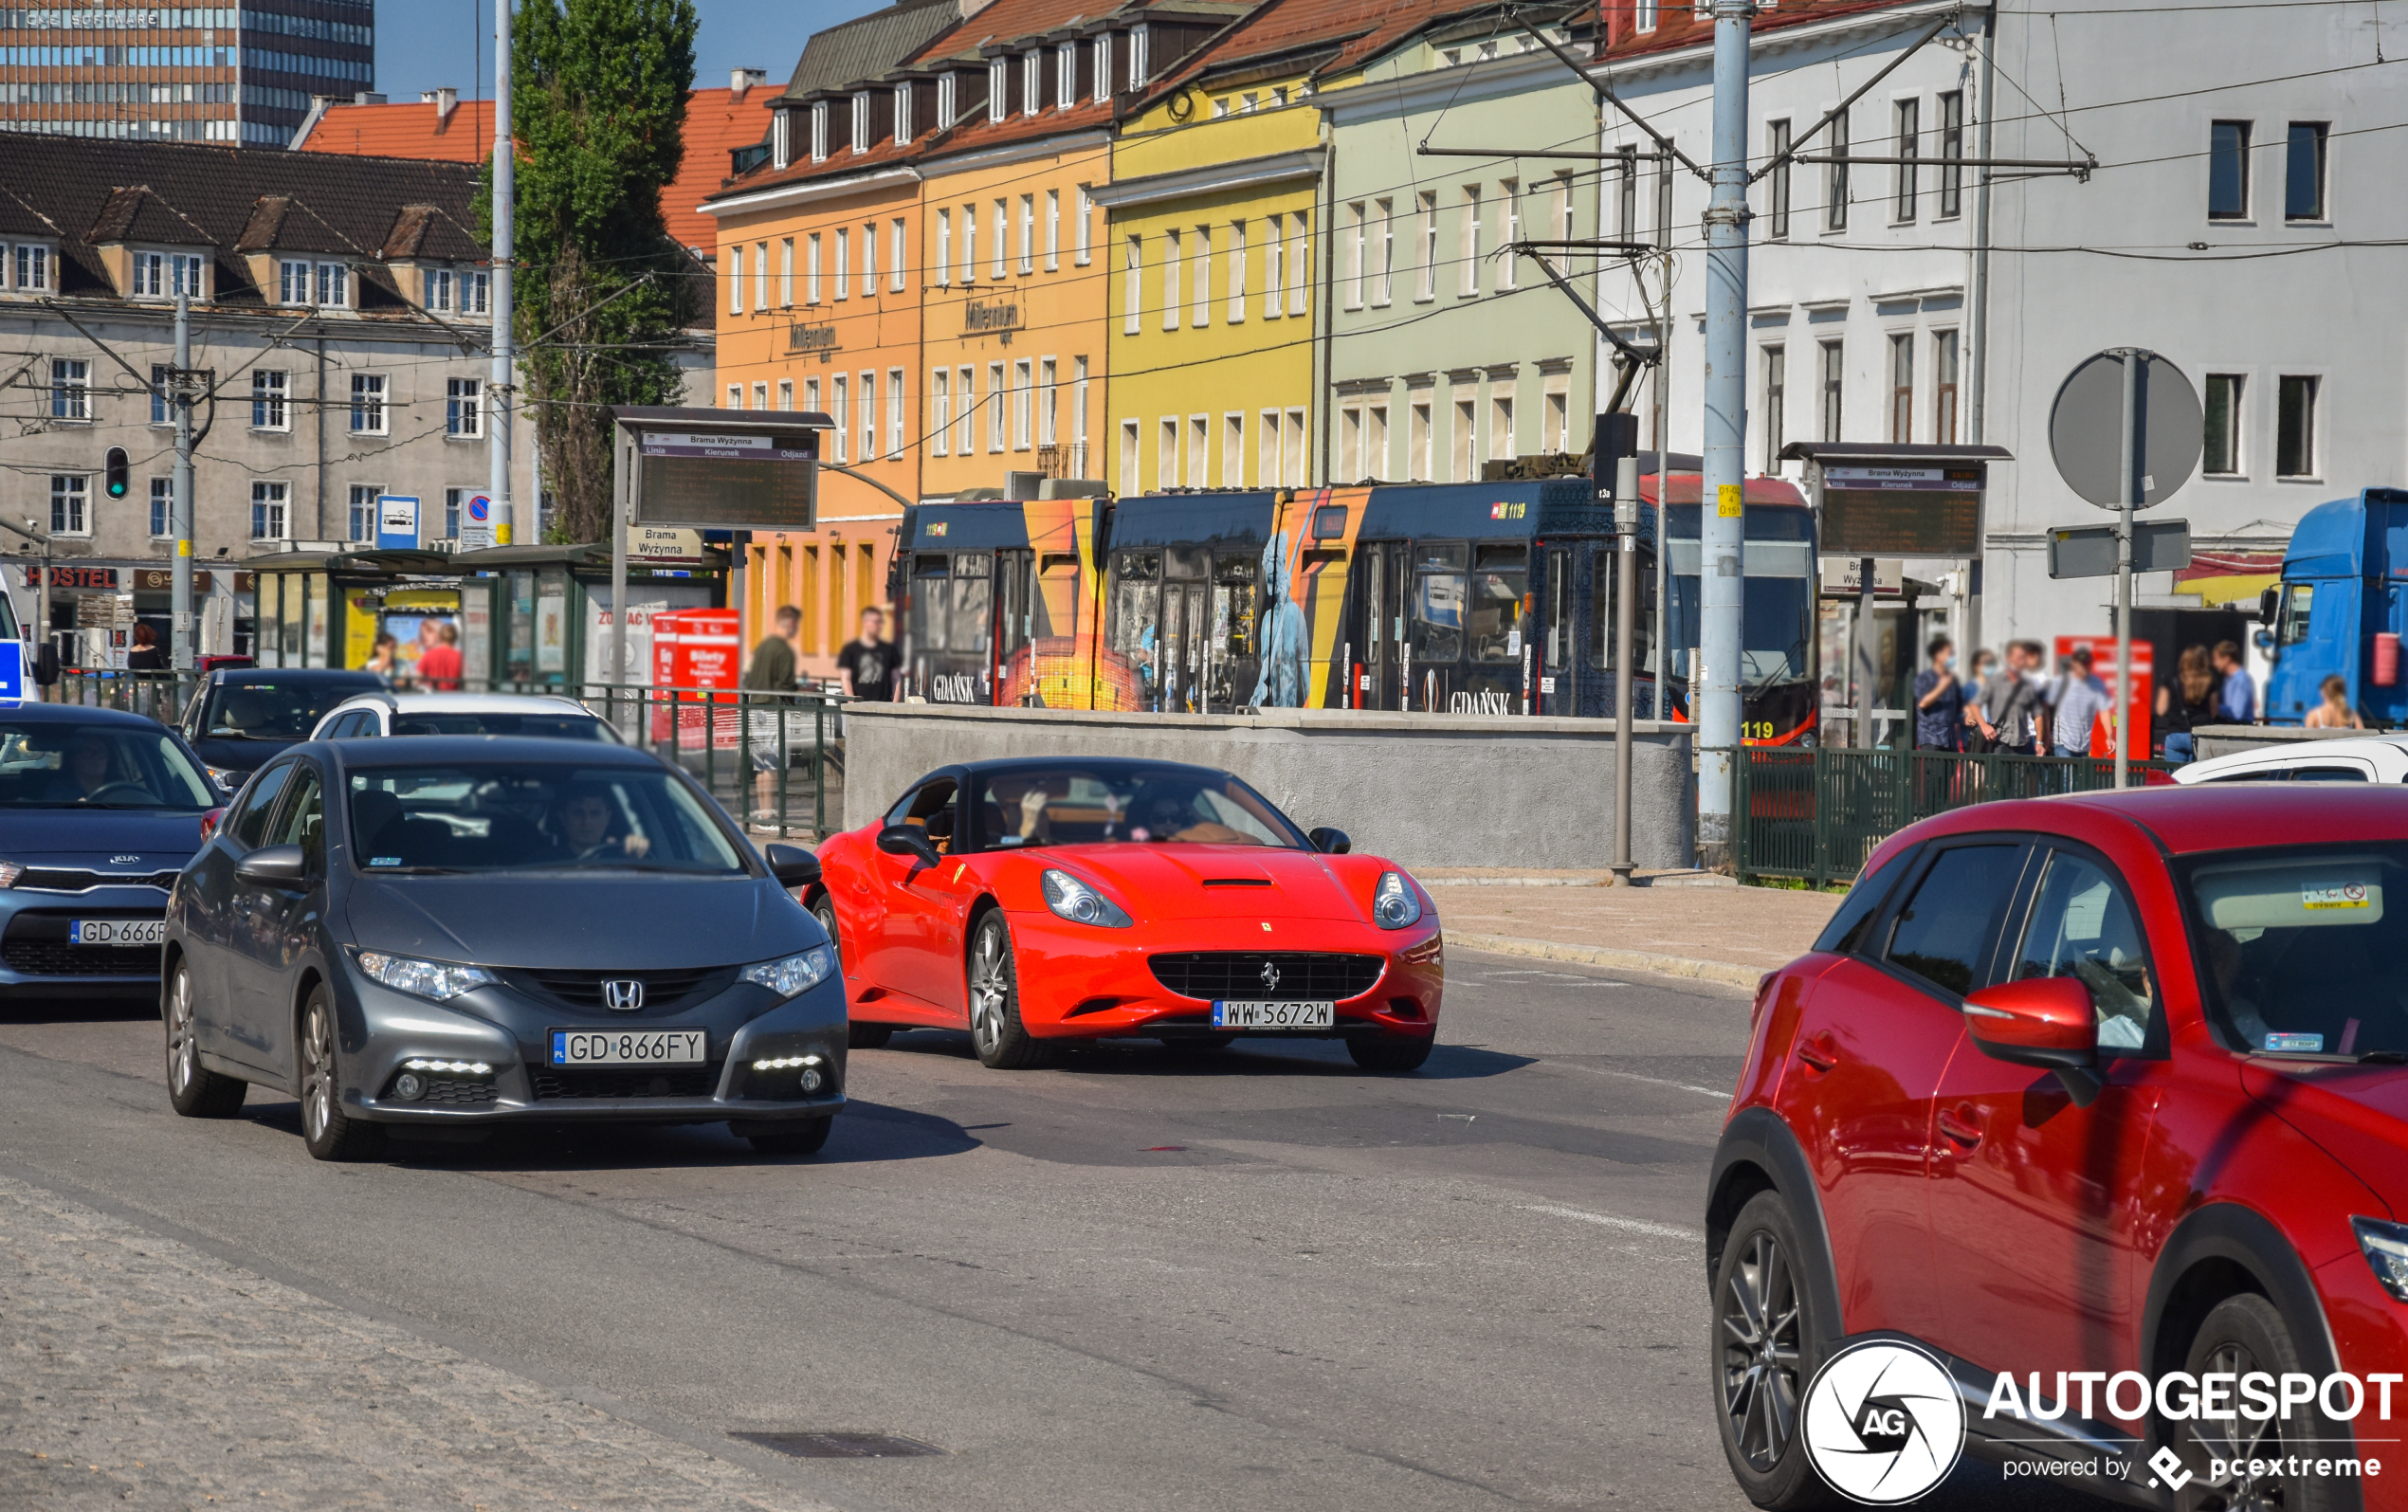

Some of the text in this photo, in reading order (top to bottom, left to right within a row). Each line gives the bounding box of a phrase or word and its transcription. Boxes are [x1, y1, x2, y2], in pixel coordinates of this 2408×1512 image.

[71, 14, 157, 26] SOFTWARE
[965, 298, 1018, 331] Millennium
[790, 318, 836, 350] Millennium
[690, 436, 753, 446] Brama Wyżynna
[704, 448, 739, 457] Kierunek
[780, 450, 808, 459] Odjazd
[1893, 470, 1925, 479] Wyżynna
[1508, 502, 1526, 519] 1119
[645, 529, 677, 539] Brama
[926, 523, 938, 537] 1119
[638, 543, 683, 556] Wyżynna
[1850, 561, 1877, 571] Bra
[27, 567, 117, 589] HOSTEL
[689, 649, 727, 665] Bilety
[934, 672, 975, 702] GDAŃSK
[1450, 687, 1511, 716] GDAŃSK
[1228, 1003, 1328, 1025] WW 5672W
[570, 1033, 699, 1060] GD 866FY
